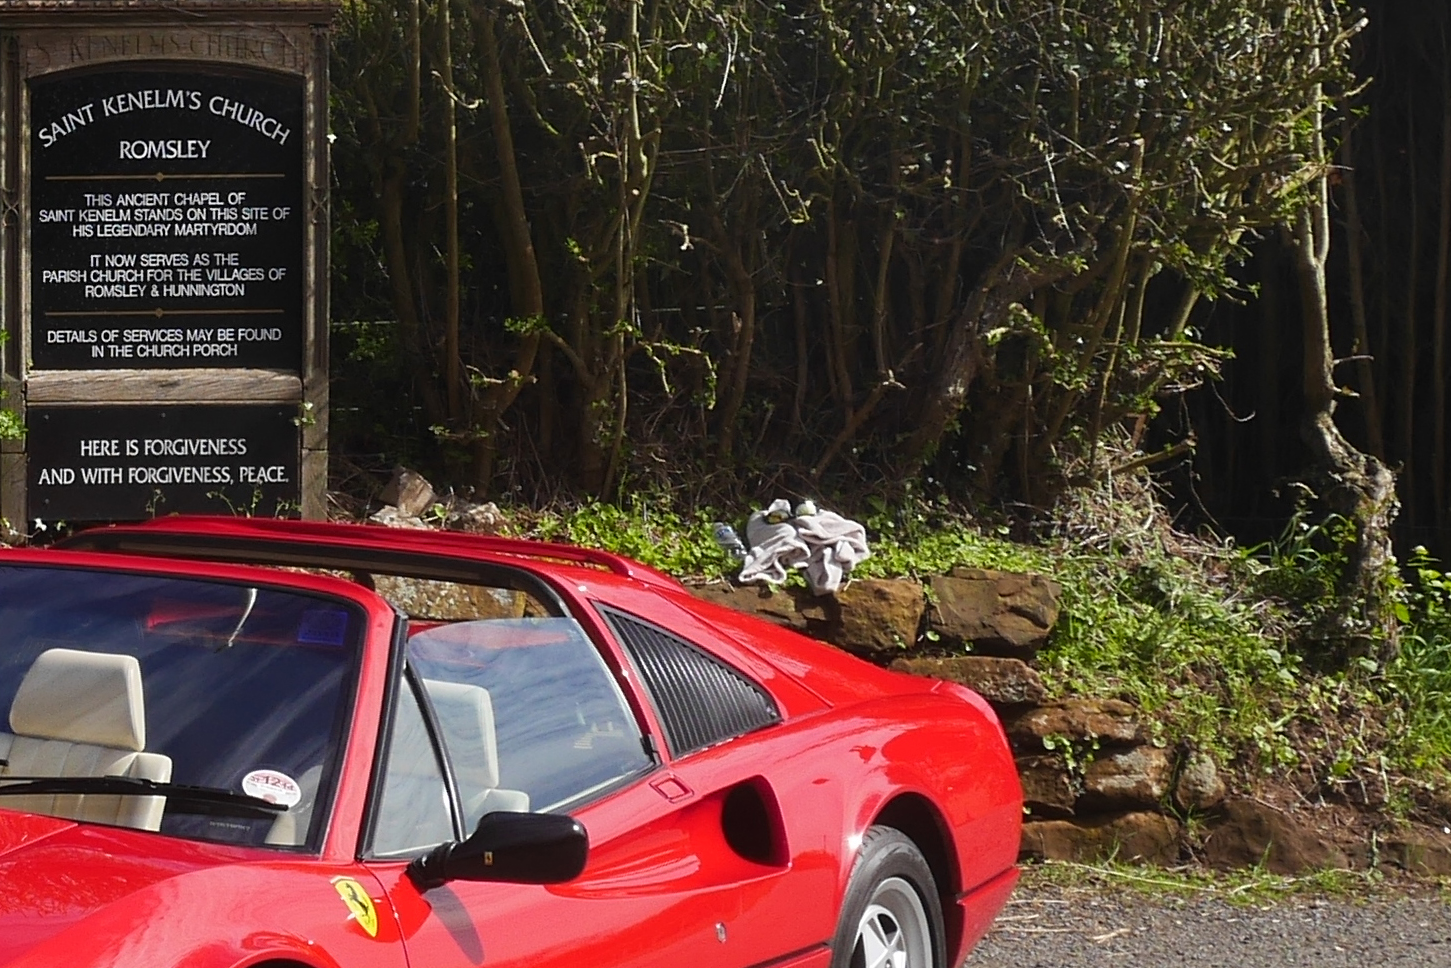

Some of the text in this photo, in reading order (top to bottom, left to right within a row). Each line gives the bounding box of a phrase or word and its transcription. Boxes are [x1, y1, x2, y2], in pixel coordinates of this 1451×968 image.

[38, 89, 291, 148] SAINT KENELM'S CHURCH
[120, 140, 210, 159] ROMSLEY
[84, 192, 246, 206] THIS ANCIENT CHAPEL OF
[39, 208, 290, 222] SAINT KENELM STANDS ON THIS SITE OF
[73, 223, 256, 237] HIS LEGENDARY MARTYRDOM
[91, 253, 238, 267] IT NOW SERVES AS THE
[43, 268, 286, 282] PARISH CHURCH FOR THE VILLAGES OF
[85, 284, 244, 297] ROMSLEY & HUNNINGTON
[48, 329, 281, 343] DETAILS OF SERVICES MAY BE FOUND
[92, 344, 237, 357] IN THE CHURCH PORCH
[81, 439, 246, 456] HERE IS FORGIVENESS
[39, 466, 288, 484] AND WITH FORGIVENESS, PEACE.
